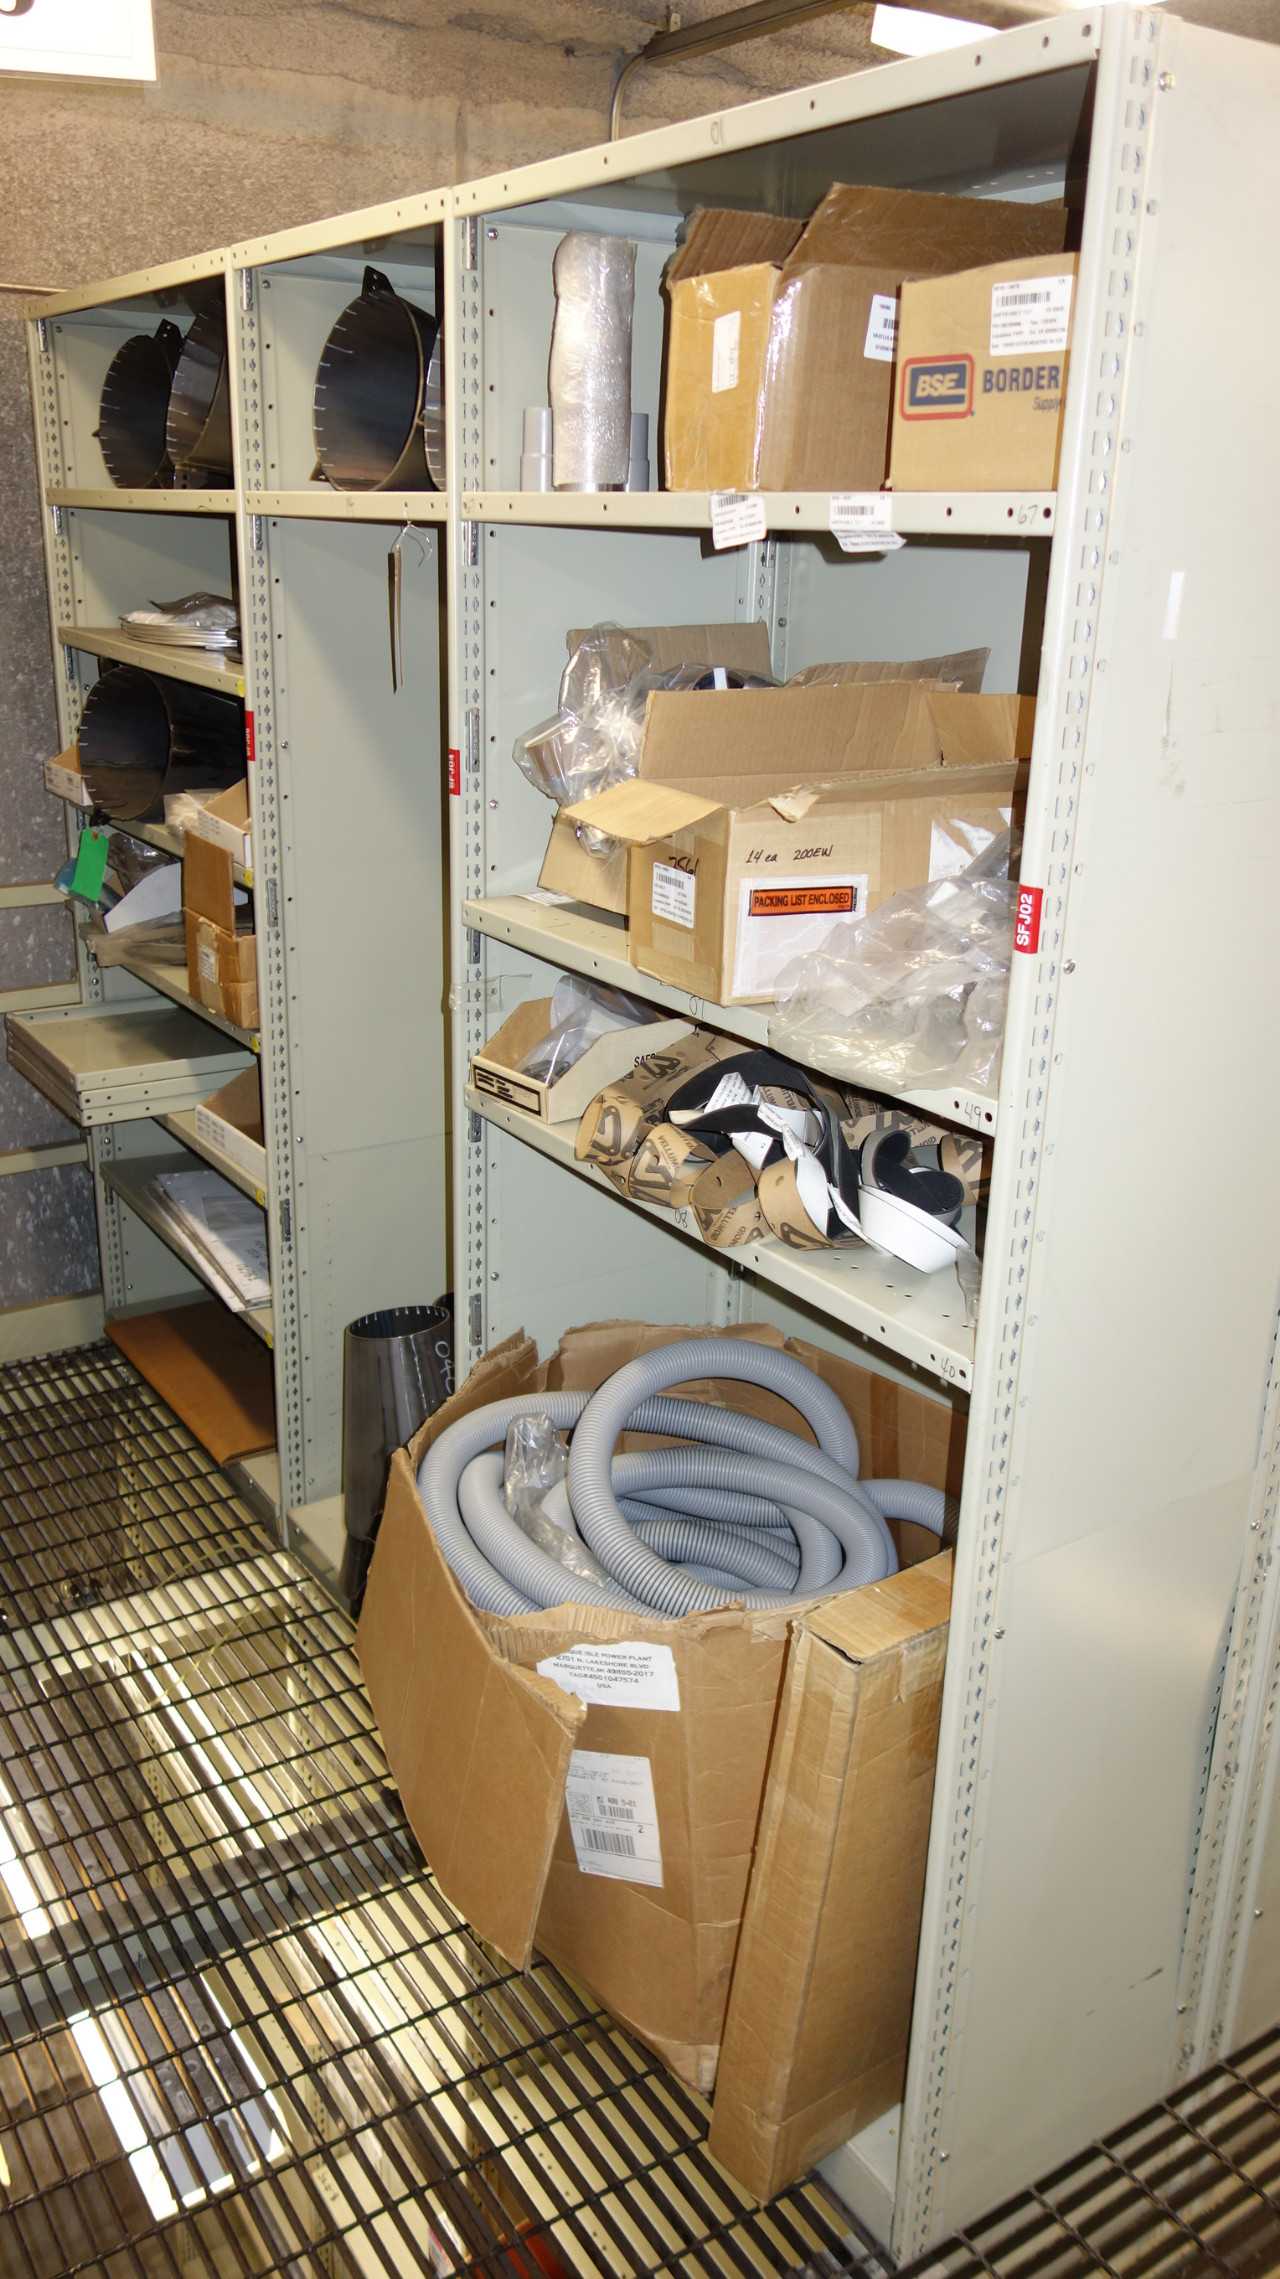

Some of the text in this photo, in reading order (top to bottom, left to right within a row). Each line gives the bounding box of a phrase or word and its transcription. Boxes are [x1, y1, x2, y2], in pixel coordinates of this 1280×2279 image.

[915, 372, 966, 398] BSE
[982, 365, 1060, 394] BORDER
[1018, 503, 1039, 525] 67
[754, 895, 789, 908] PACKING
[790, 894, 807, 906] LIST
[808, 892, 850, 905] ENCLOSED
[1016, 893, 1033, 947] SFJ02
[964, 1101, 982, 1128] 49
[941, 1358, 956, 1378] 40
